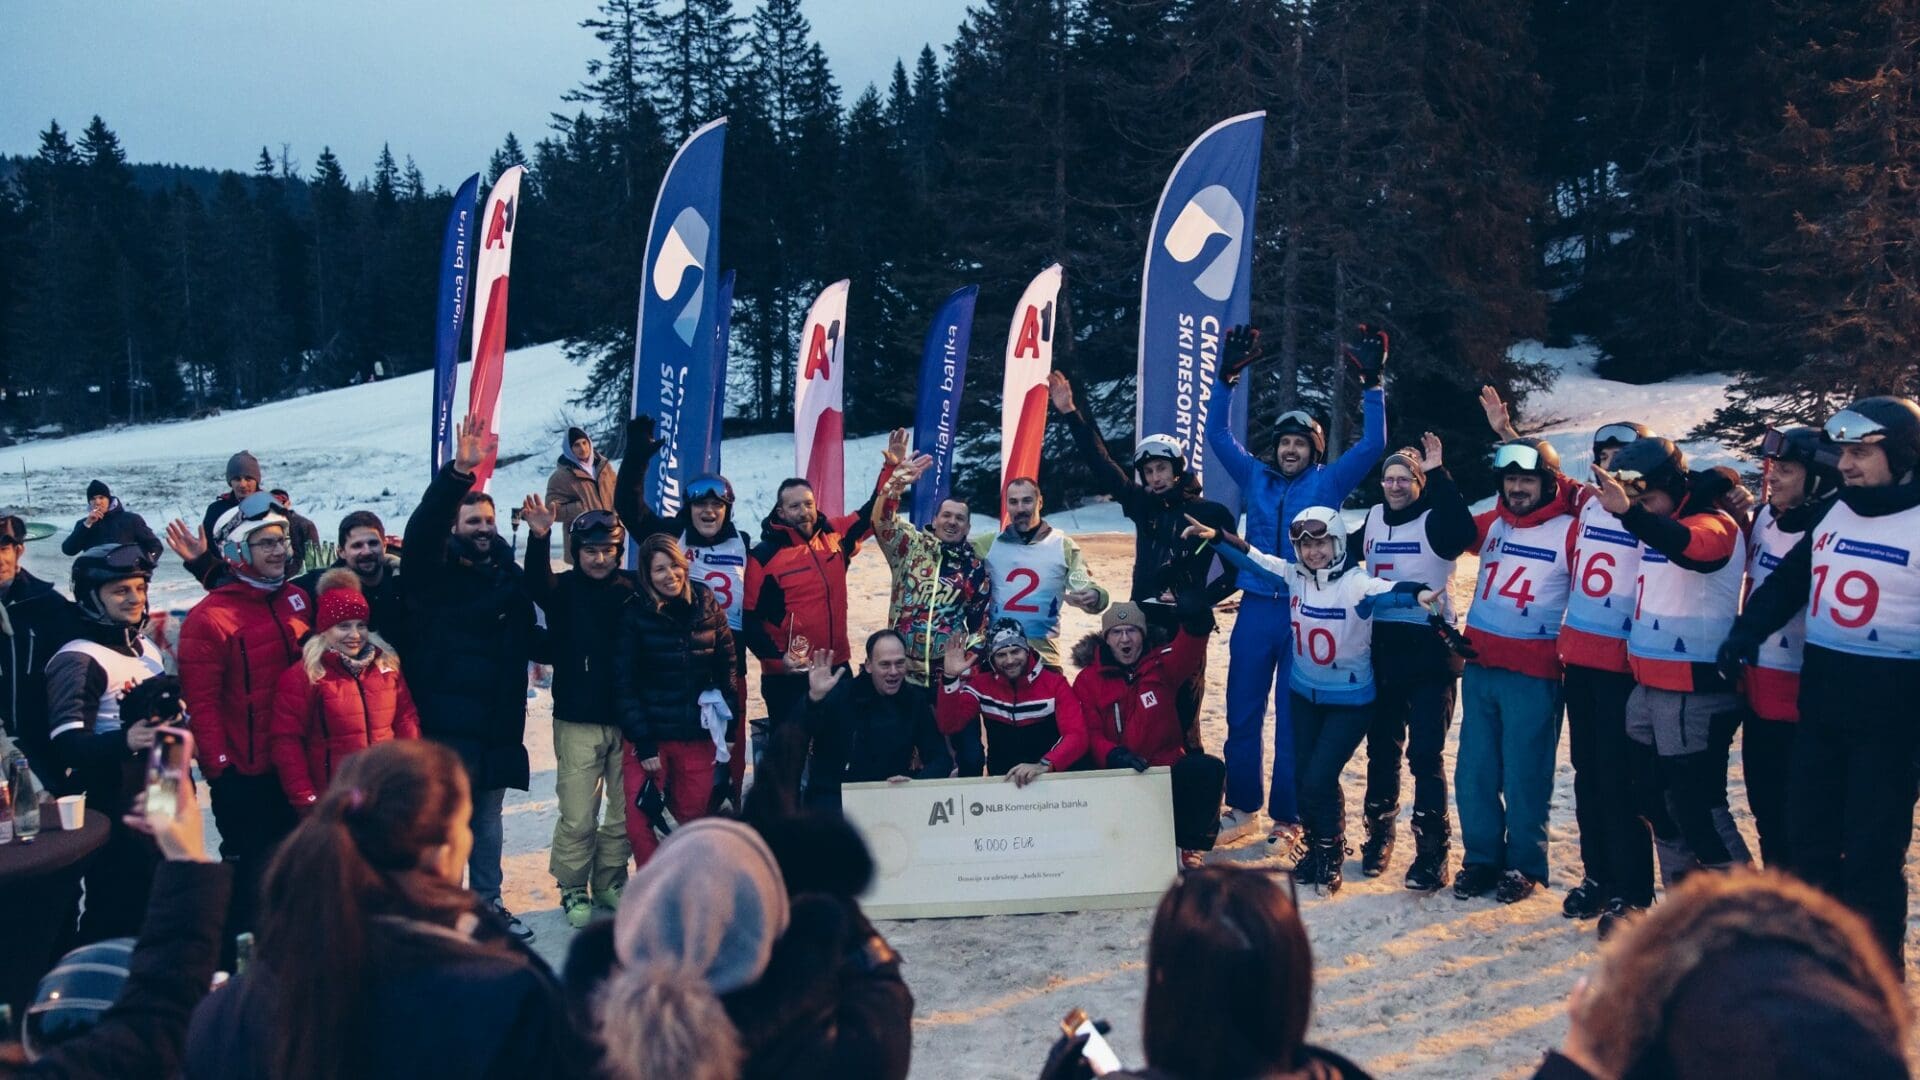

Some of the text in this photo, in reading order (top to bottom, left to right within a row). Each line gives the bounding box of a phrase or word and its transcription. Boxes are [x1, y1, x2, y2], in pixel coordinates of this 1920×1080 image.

[486, 195, 514, 250] A1
[1015, 301, 1052, 358] A1
[1178, 313, 1193, 350] SKI
[804, 320, 840, 381] A1
[660, 363, 674, 407] SKI
[685, 548, 700, 562] A1
[1365, 538, 1374, 554] A1
[1486, 537, 1501, 553] A1
[1813, 532, 1837, 552] A1
[704, 571, 733, 610] 3
[1003, 568, 1040, 613] 2
[1482, 561, 1535, 609] 14
[1571, 549, 1616, 598] 16
[1291, 595, 1302, 610] A1
[1811, 564, 1880, 628] 19
[1291, 621, 1336, 666] 10
[1145, 693, 1154, 706] A1
[928, 798, 955, 826] A1
[985, 799, 1088, 813] NLB Komercijalna banka
[1013, 836, 1035, 850] EUR
